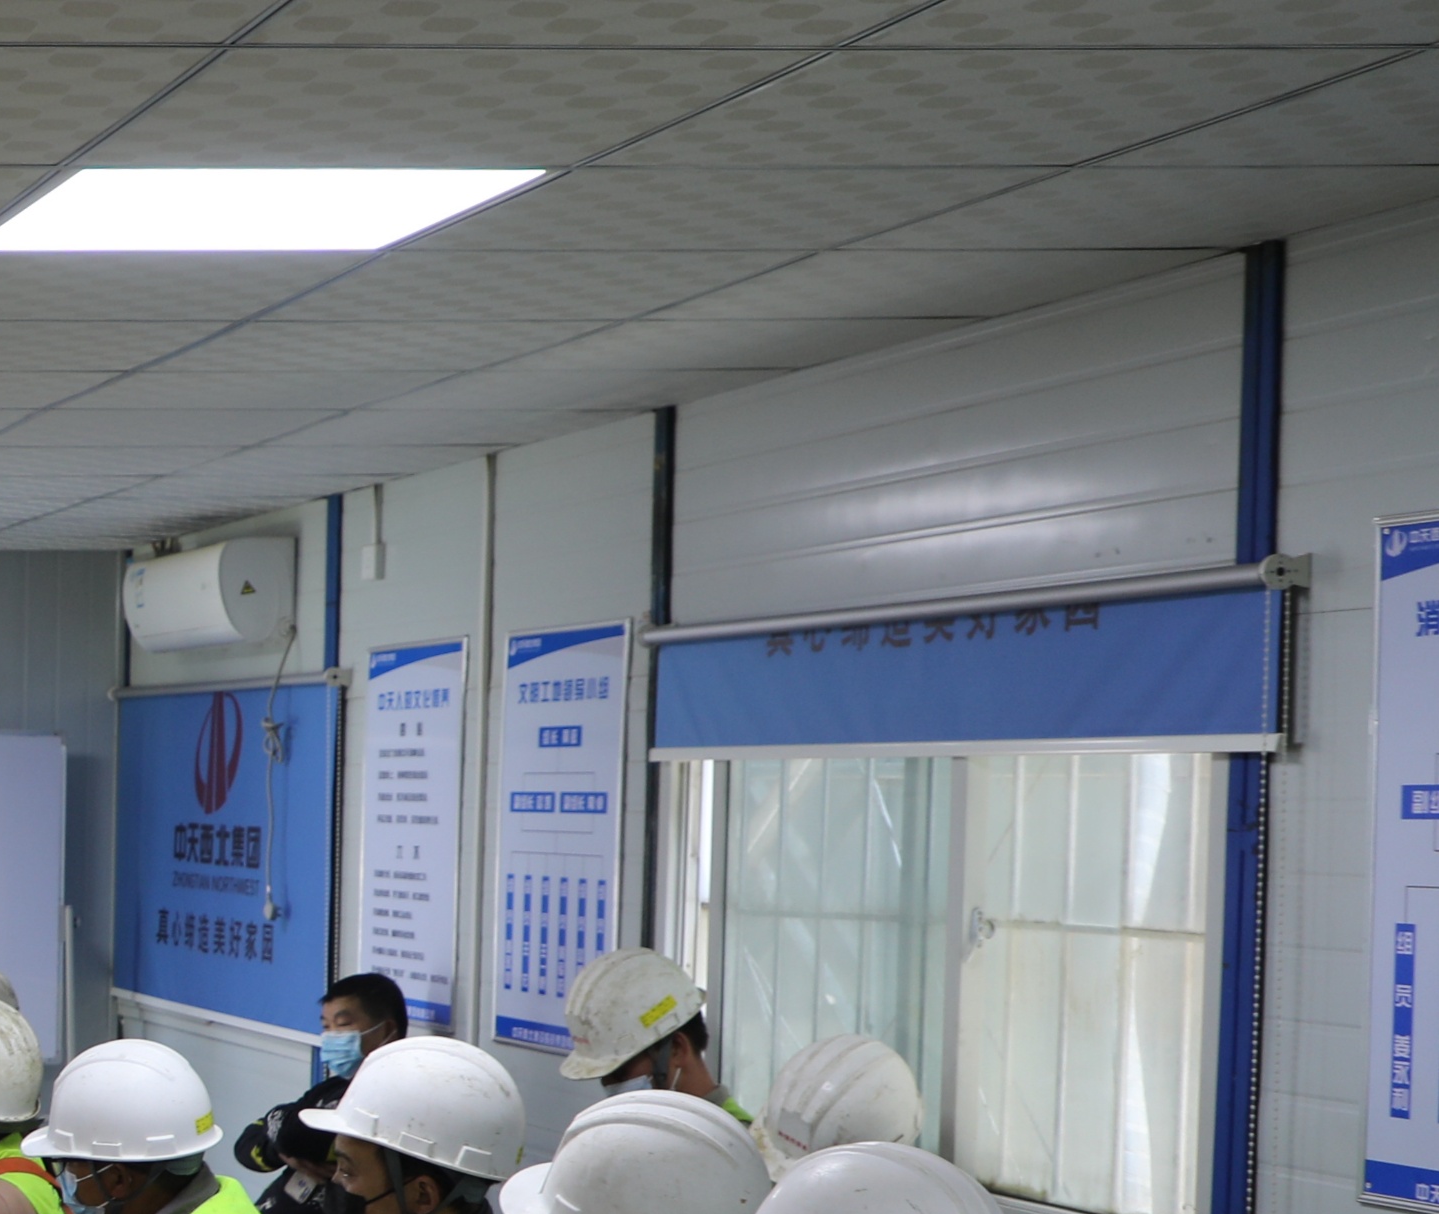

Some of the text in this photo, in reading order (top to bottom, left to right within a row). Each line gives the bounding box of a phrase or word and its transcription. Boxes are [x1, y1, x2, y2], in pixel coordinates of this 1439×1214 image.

[174, 822, 261, 869] 中天西北集团
[156, 907, 274, 964] 真心缔造美好家园
